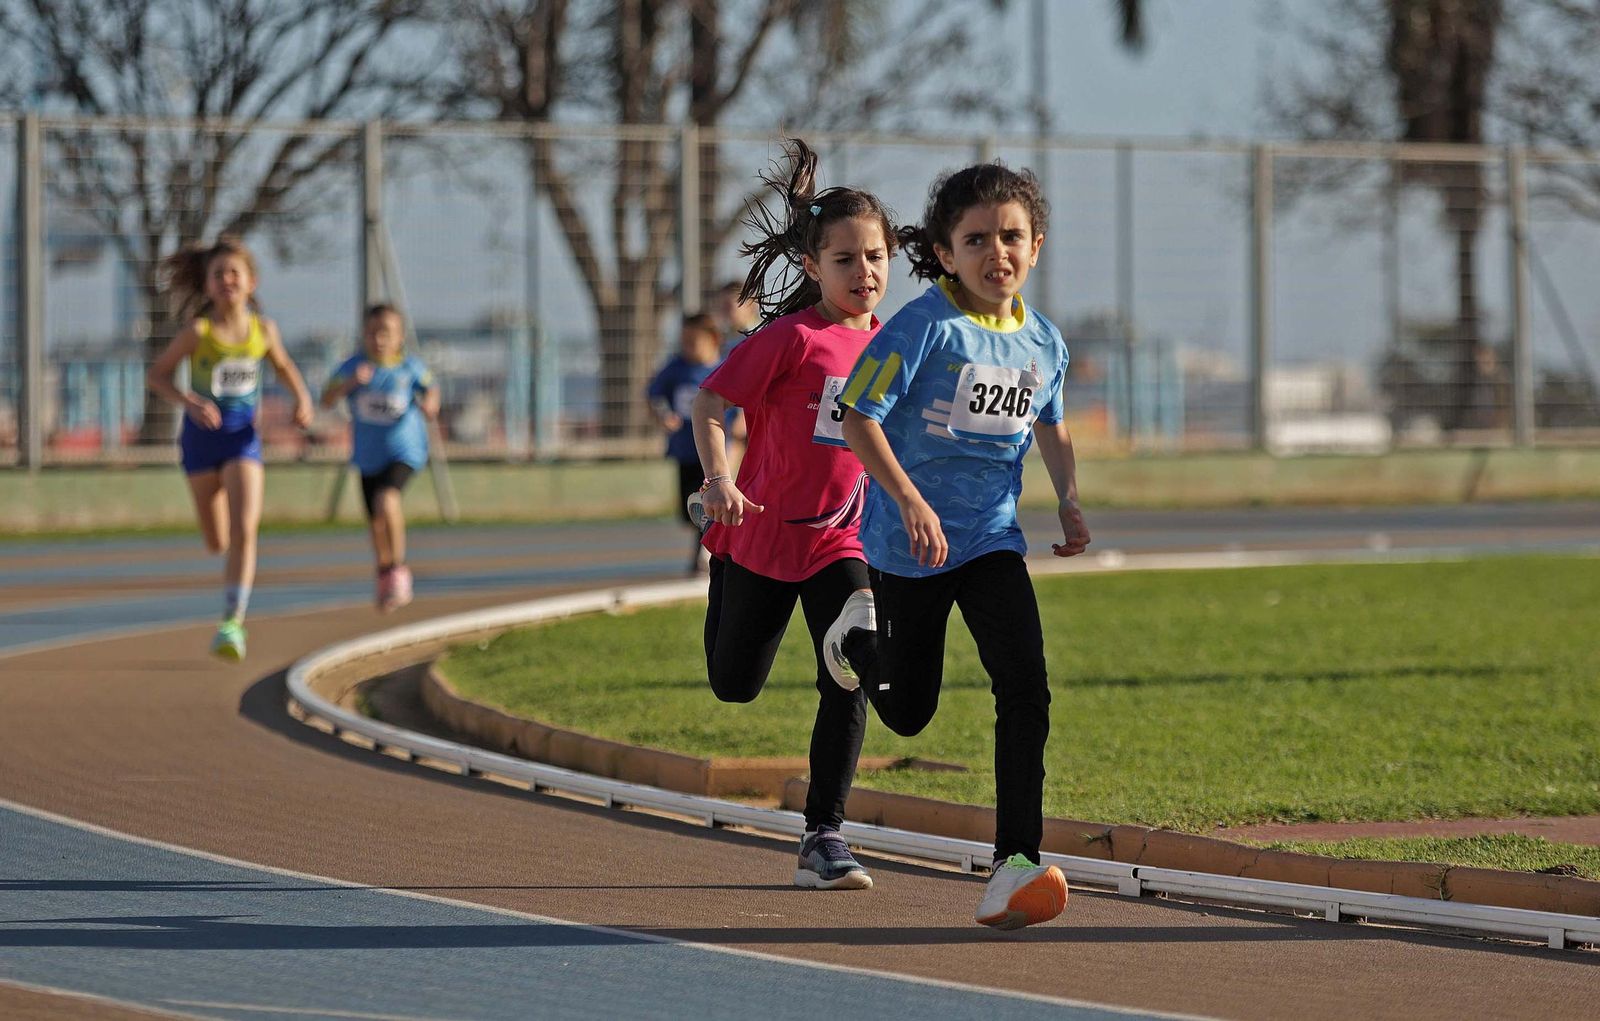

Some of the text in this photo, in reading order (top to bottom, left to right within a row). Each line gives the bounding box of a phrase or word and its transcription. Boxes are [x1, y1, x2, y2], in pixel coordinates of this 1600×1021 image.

[810, 392, 822, 402] IN
[831, 394, 849, 422] 3
[969, 383, 1032, 418] 3246
